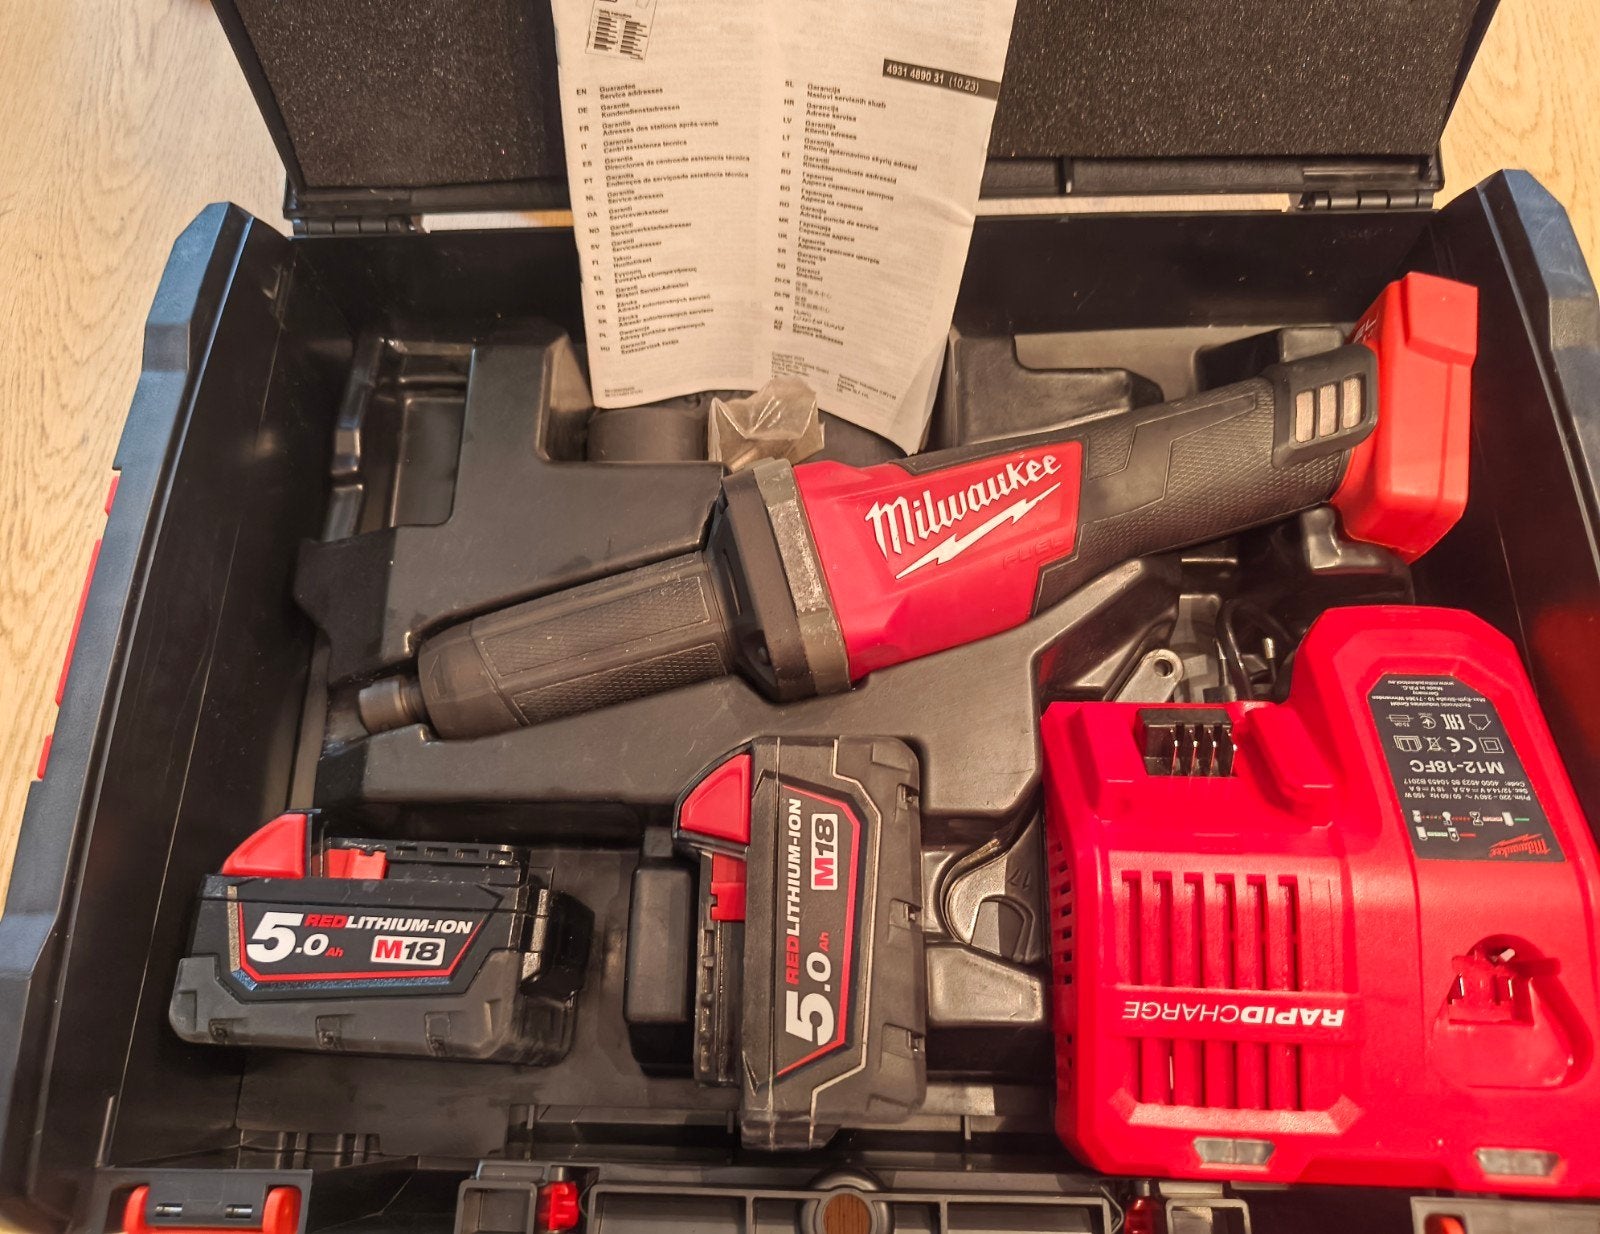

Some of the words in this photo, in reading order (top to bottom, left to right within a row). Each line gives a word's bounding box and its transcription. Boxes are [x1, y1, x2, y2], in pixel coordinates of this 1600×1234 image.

[600, 83, 636, 92] Guarantee
[887, 64, 908, 77] 4931
[910, 68, 931, 81] 4890
[934, 73, 944, 84] 31
[949, 77, 979, 94] (10.23)
[600, 92, 626, 100] Service
[628, 88, 663, 96] addresses
[807, 91, 833, 100] Naslovi
[602, 105, 680, 118] Kundendienstadressen
[806, 110, 830, 118] Adrese
[603, 128, 634, 136] Adresses
[650, 122, 677, 130] stations
[864, 454, 1062, 564] Milwaukee
[1410, 760, 1505, 774] M12-18FC
[814, 817, 835, 886] M18
[1490, 838, 1551, 857] Milwaukee
[786, 798, 801, 985] REDLITHIUM-ION
[304, 914, 473, 934] REDLITHIUM-ION
[246, 911, 329, 963] 5.0
[325, 947, 344, 958] Ah
[375, 940, 441, 961] M18
[785, 952, 835, 1046] 5.0
[819, 932, 830, 952] Ah
[1122, 1001, 1345, 1027] RAPIDCHARGE
